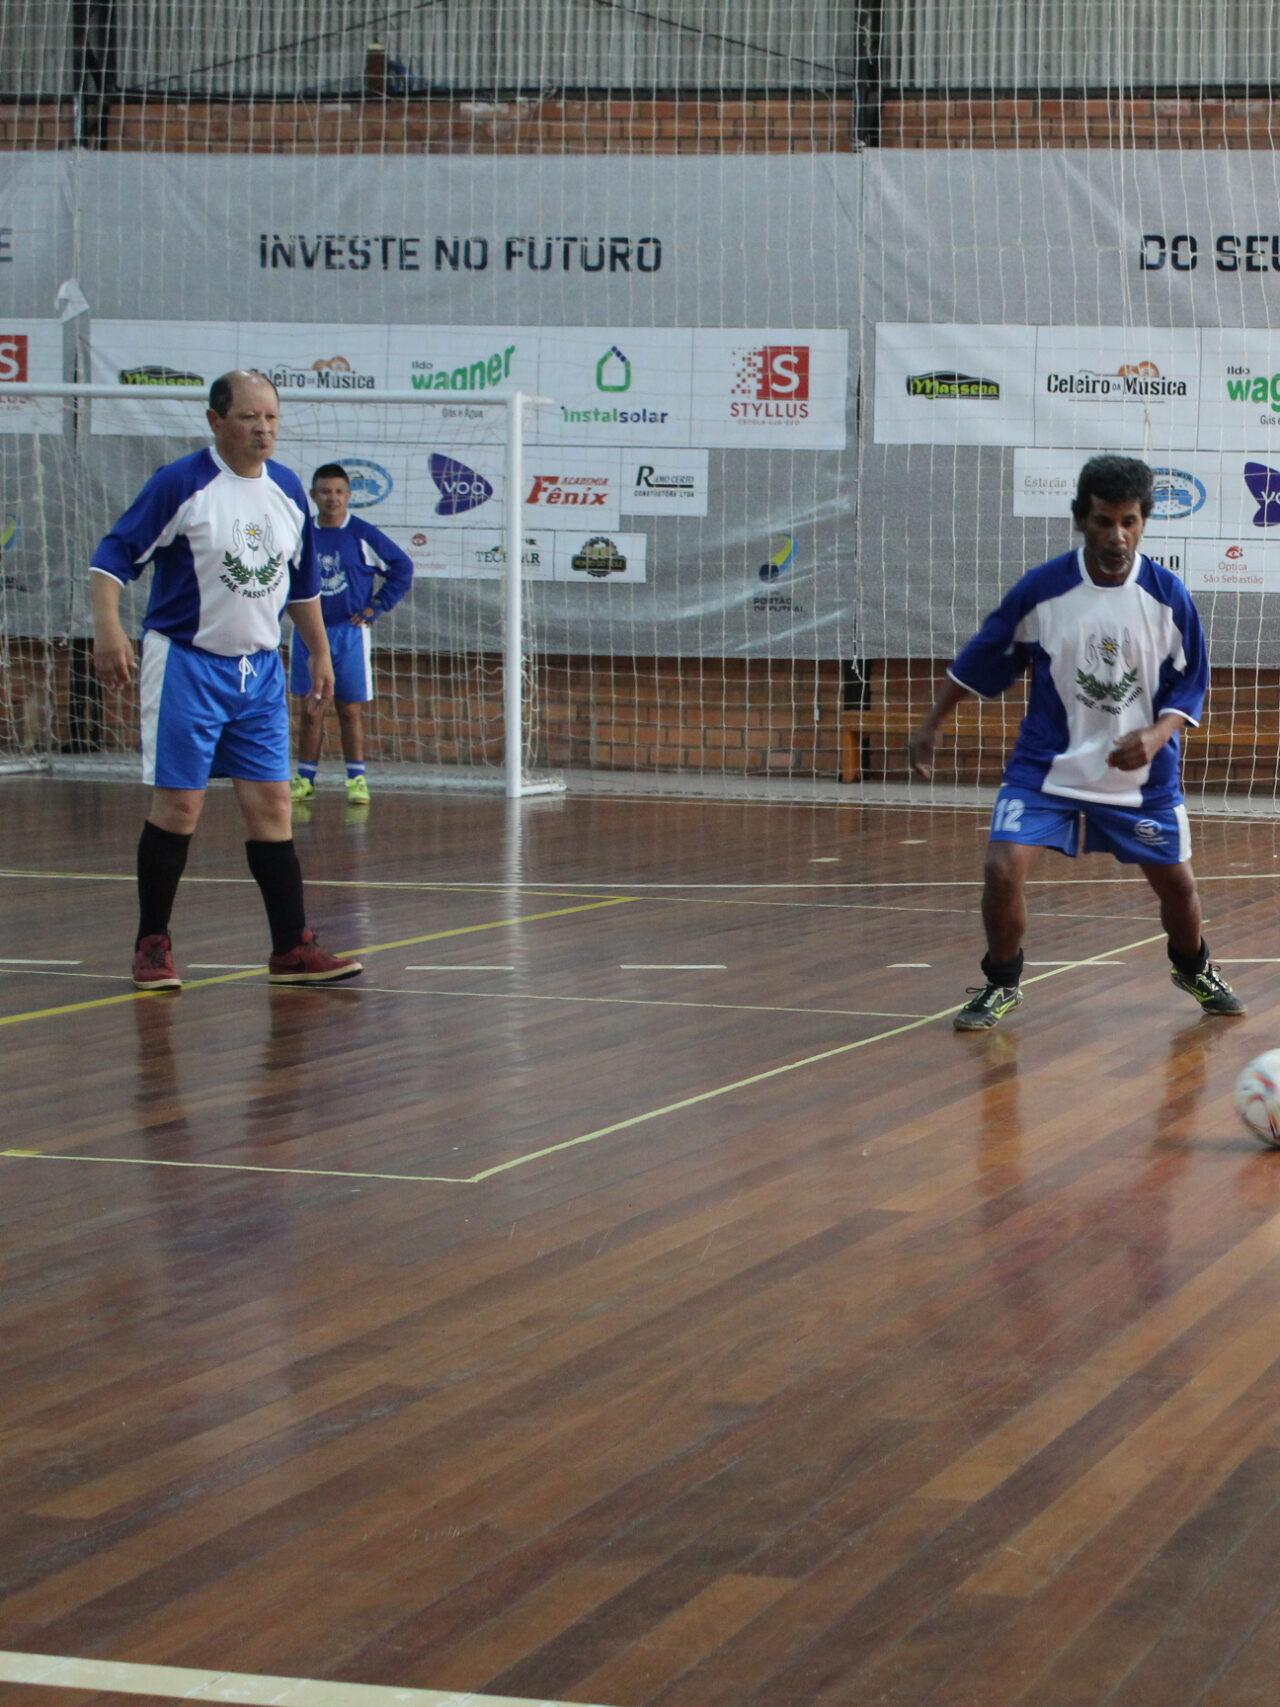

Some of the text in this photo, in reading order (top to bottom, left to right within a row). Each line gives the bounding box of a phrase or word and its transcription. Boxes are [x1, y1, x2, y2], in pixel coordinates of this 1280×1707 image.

[260, 234, 663, 272] INVESTE NO FUTURO
[1140, 235, 1198, 272] DO
[1227, 366, 1251, 376] Ildo
[1047, 374, 1111, 394] Celeiro
[1123, 376, 1188, 396] Música
[561, 406, 668, 424] instalsolar
[730, 403, 809, 419] STYLLUS
[525, 475, 609, 505] Fênix
[994, 798, 1025, 833] 12
